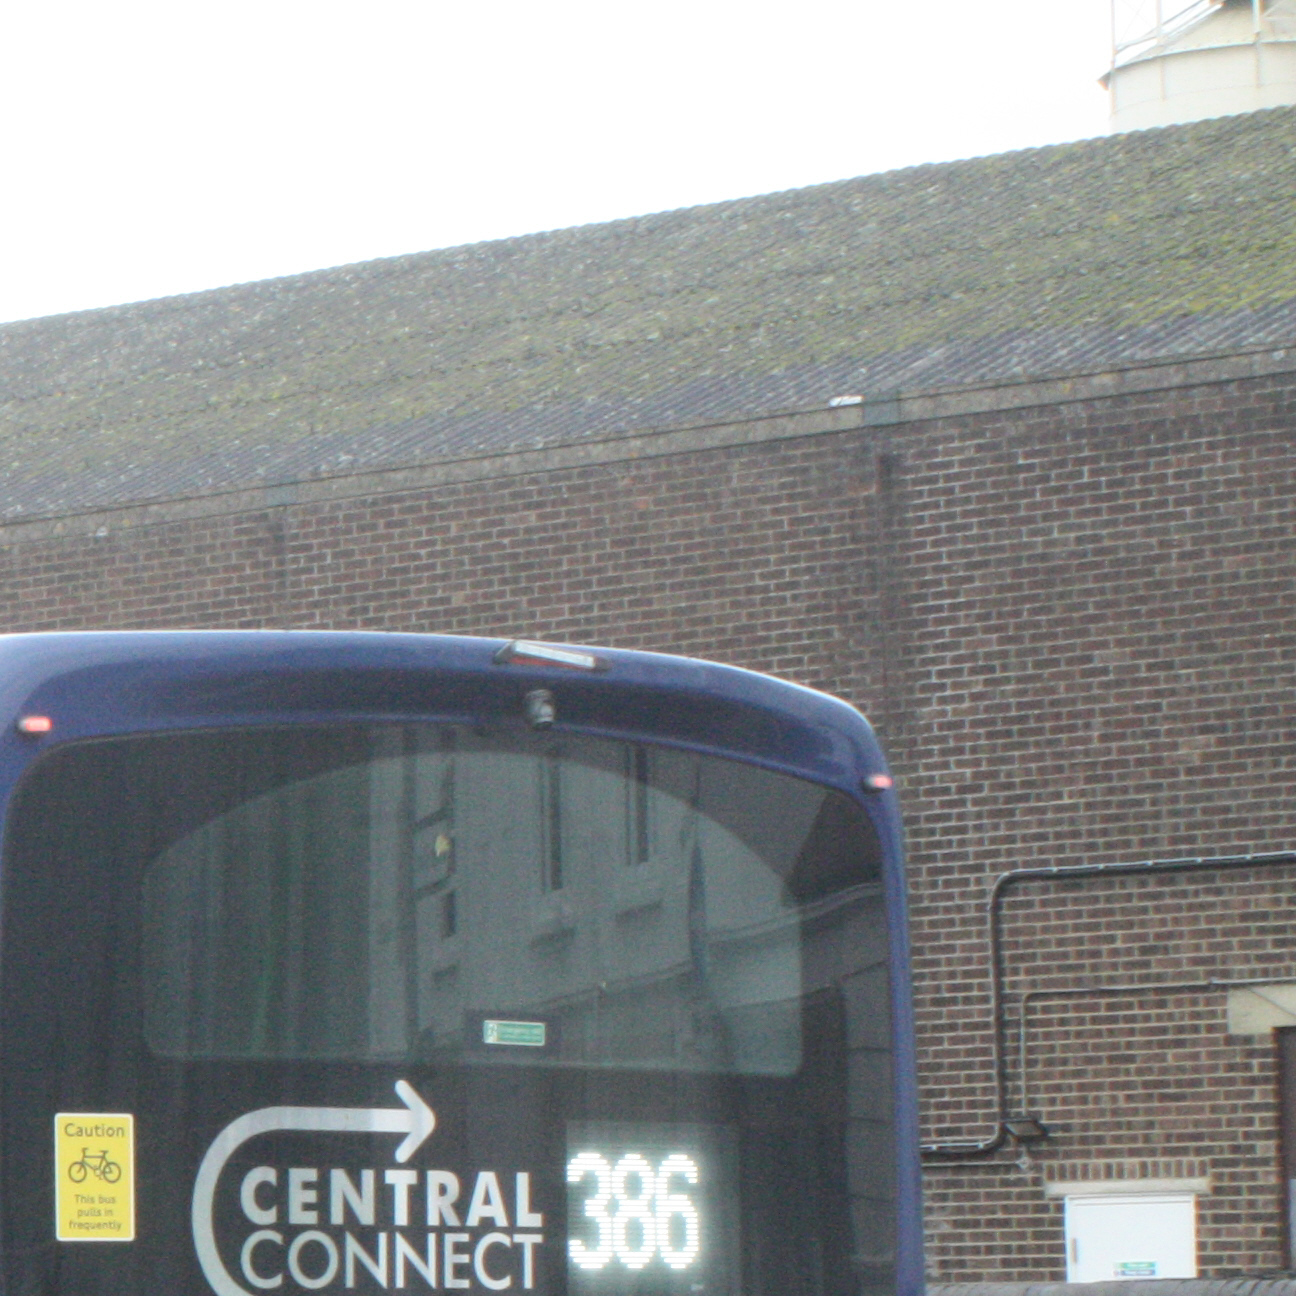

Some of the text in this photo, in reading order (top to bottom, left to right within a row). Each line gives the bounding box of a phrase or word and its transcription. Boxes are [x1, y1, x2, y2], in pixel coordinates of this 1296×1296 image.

[64, 1123, 125, 1138] Caution
[74, 1194, 116, 1204] This bus
[240, 1166, 544, 1227] CENTRAL
[77, 1208, 114, 1218] pulls in
[566, 1152, 699, 1269] 386
[68, 1220, 122, 1232] frequently
[240, 1229, 544, 1290] CONNECT
